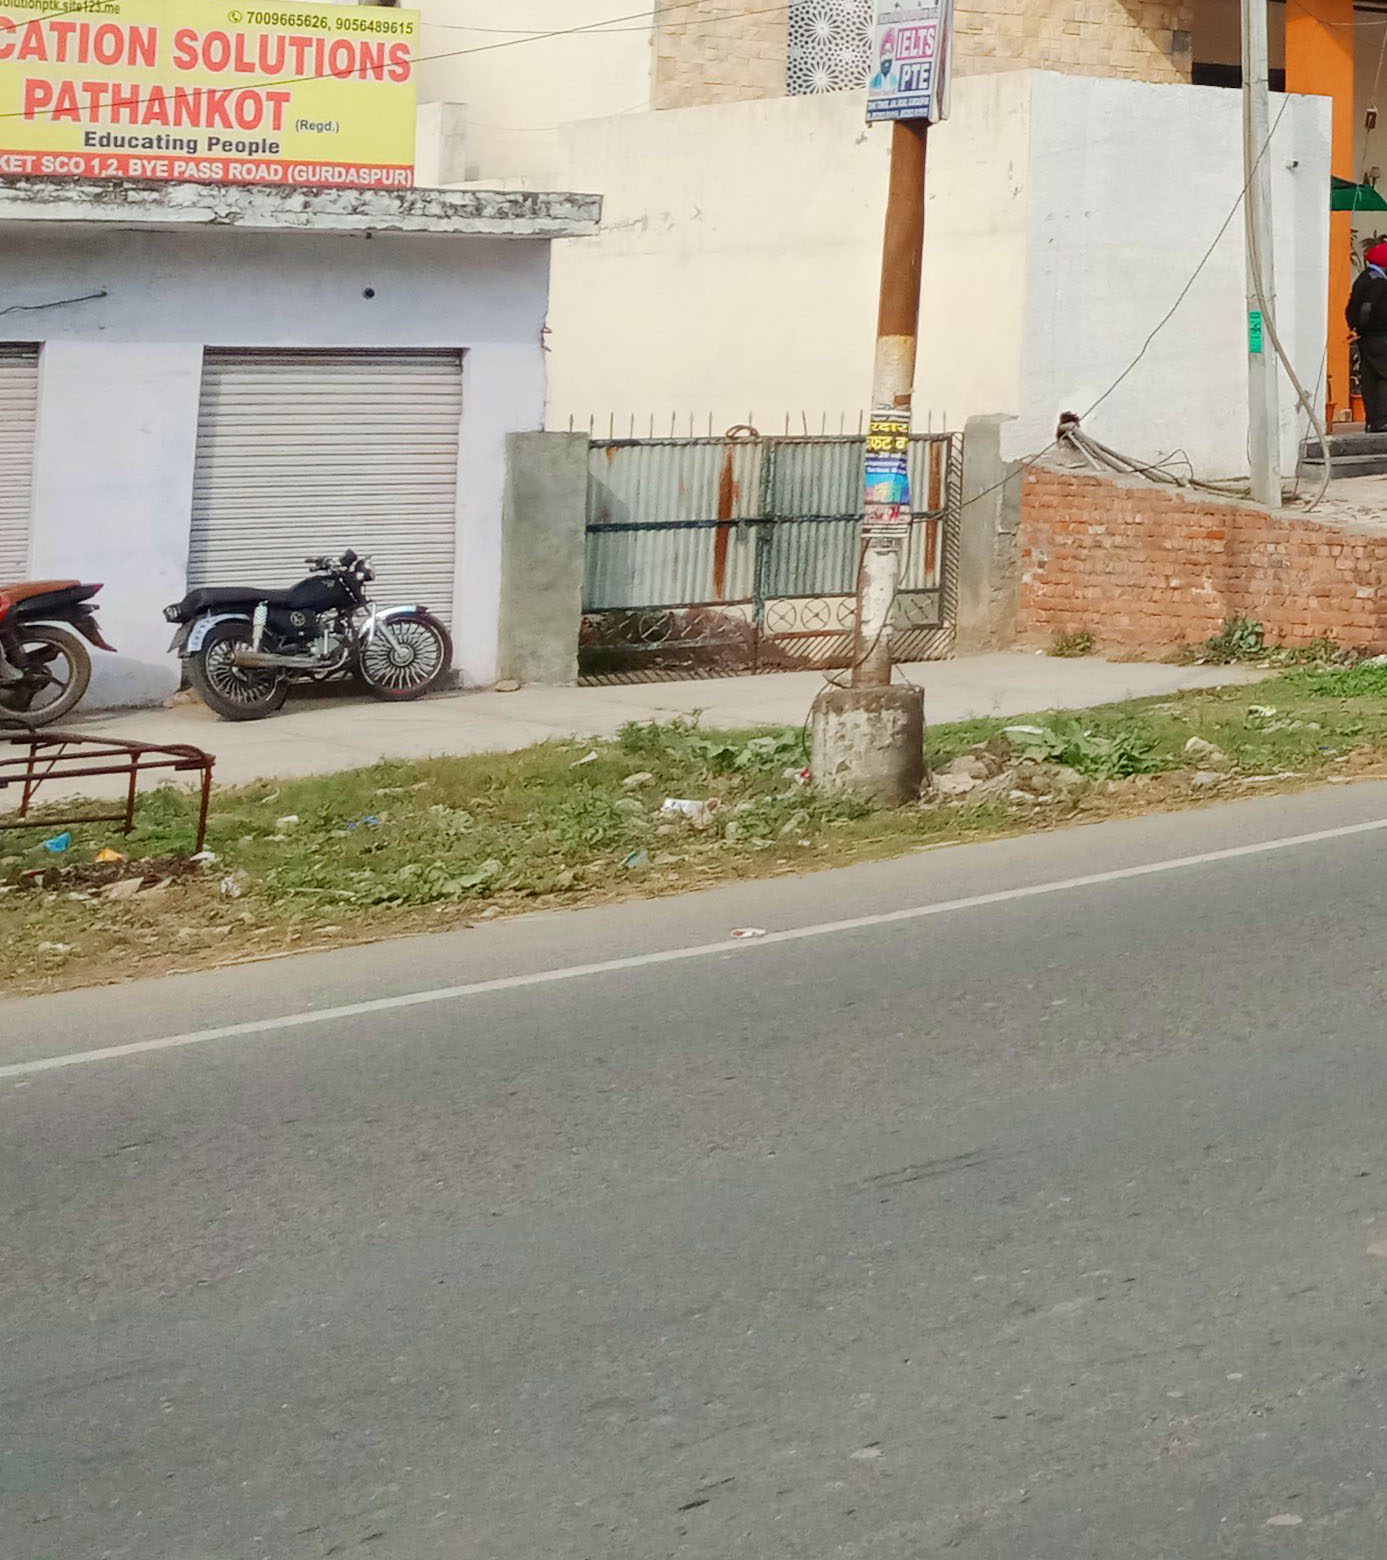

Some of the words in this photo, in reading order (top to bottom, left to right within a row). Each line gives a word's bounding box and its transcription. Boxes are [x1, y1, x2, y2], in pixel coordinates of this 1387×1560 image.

[247, 11, 331, 31] 7009665626,
[336, 18, 414, 34] 9056489615
[173, 28, 411, 82] SOLUTIONS
[896, 27, 935, 58] IELTS
[900, 63, 930, 90] PTE
[23, 78, 290, 131] PATHANKOT
[295, 119, 340, 133] (Regd.)
[84, 131, 198, 154] Educating
[207, 136, 280, 156] People
[41, 156, 85, 173] SCO
[129, 159, 168, 177] BYE
[173, 161, 223, 179] PASS
[228, 162, 282, 180] ROAD
[287, 164, 412, 187] (GURDASPUR)
